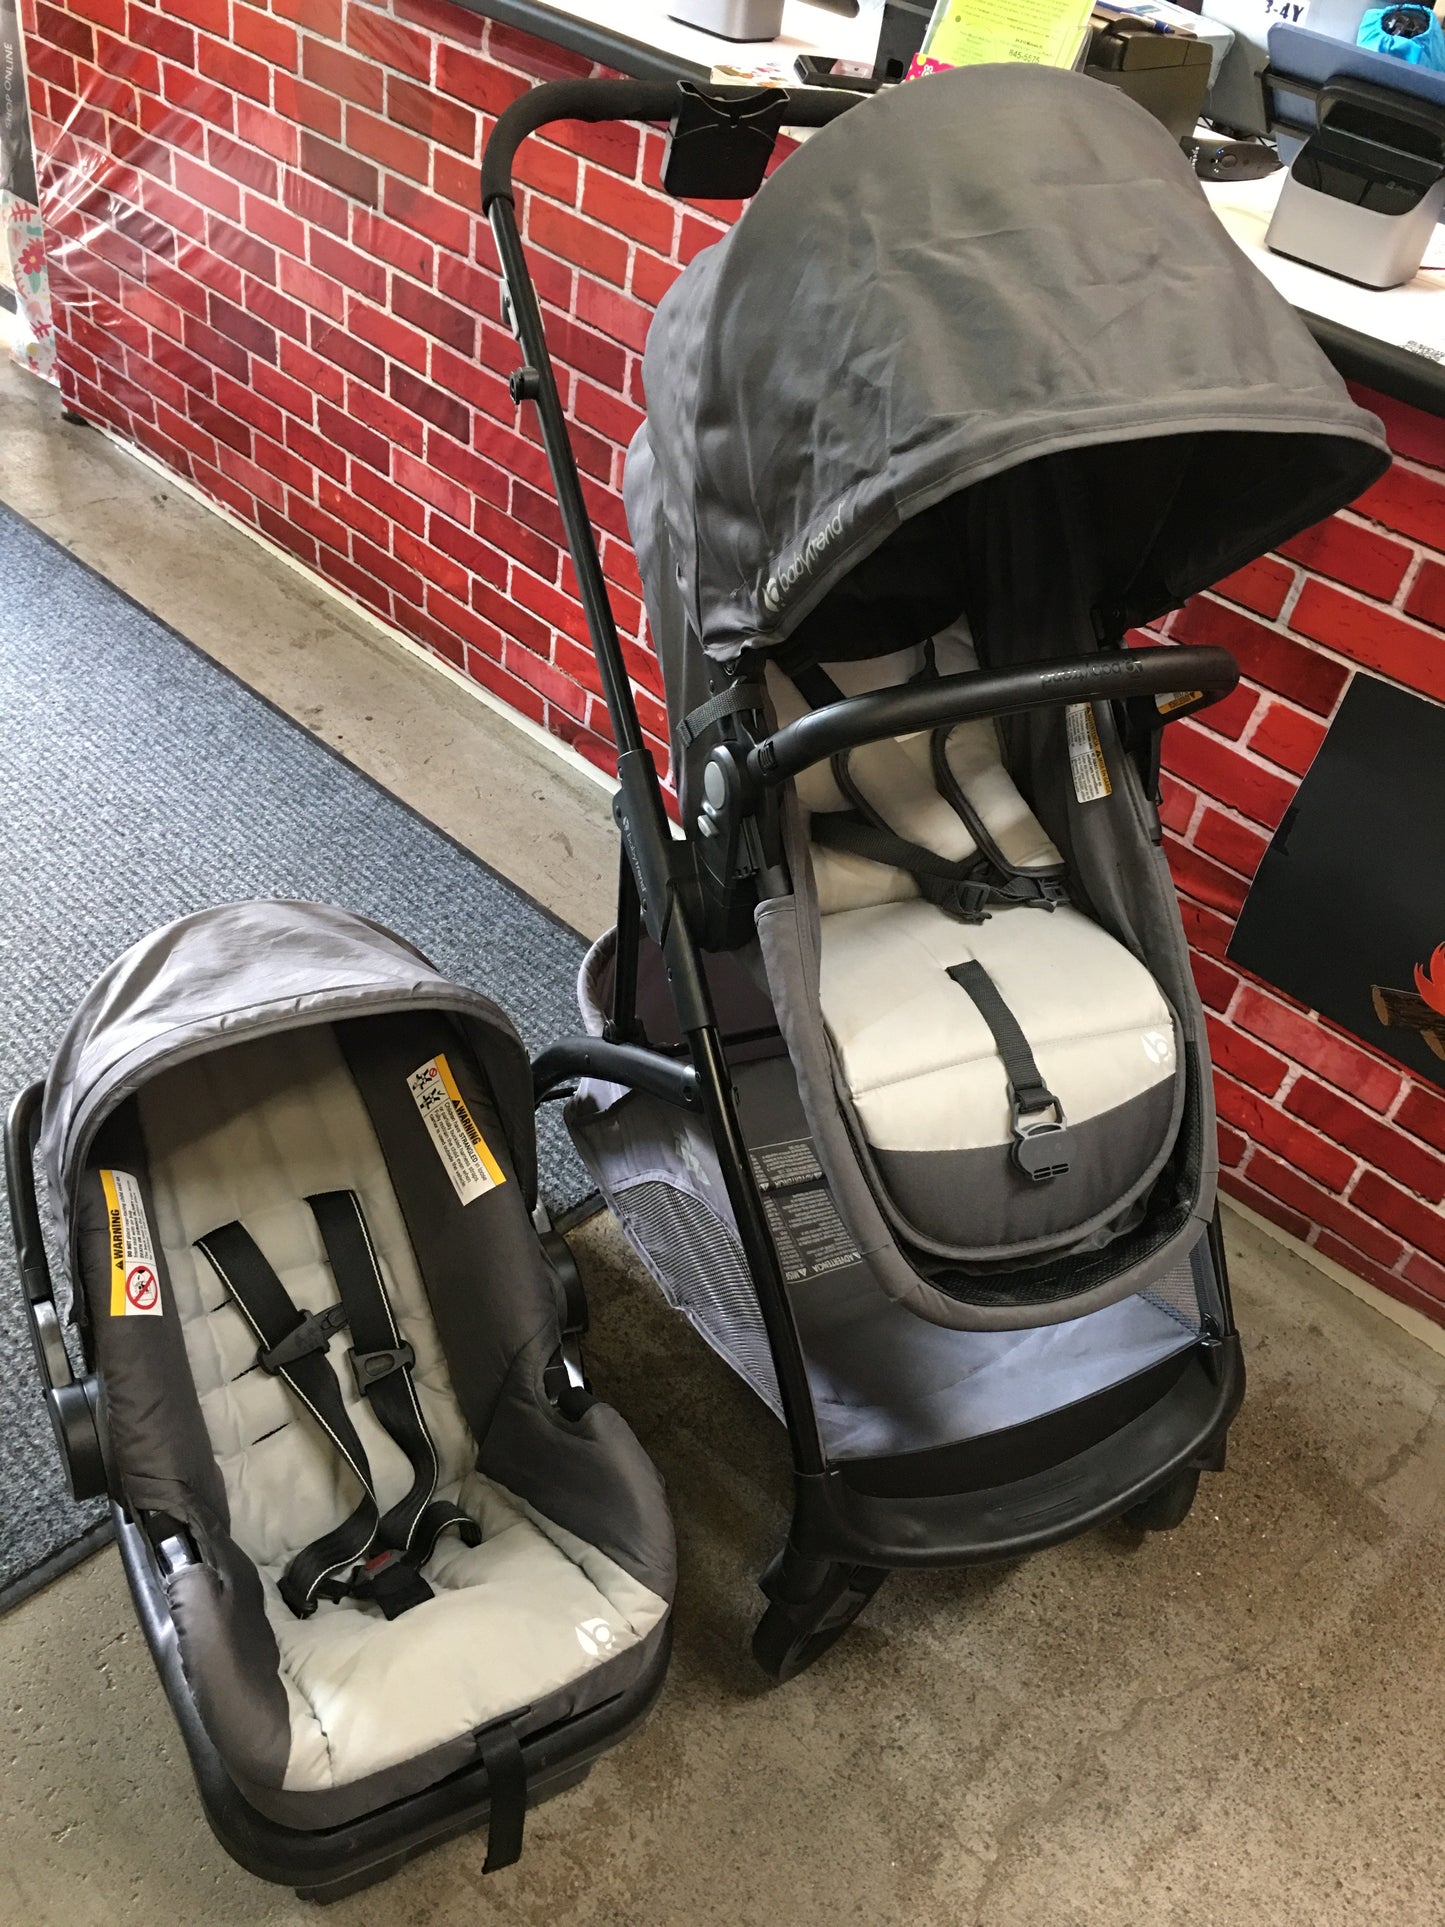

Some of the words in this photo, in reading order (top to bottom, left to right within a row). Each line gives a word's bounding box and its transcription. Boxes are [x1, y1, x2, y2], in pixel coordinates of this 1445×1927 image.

[4, 42, 14, 91] ONLINE
[5, 94, 13, 129] SHOP
[455, 1106, 481, 1145] WARNING
[459, 1132, 478, 1163] STRANGLED
[111, 1210, 122, 1259] WARNING
[812, 1254, 854, 1272] ADVERTENCIA
